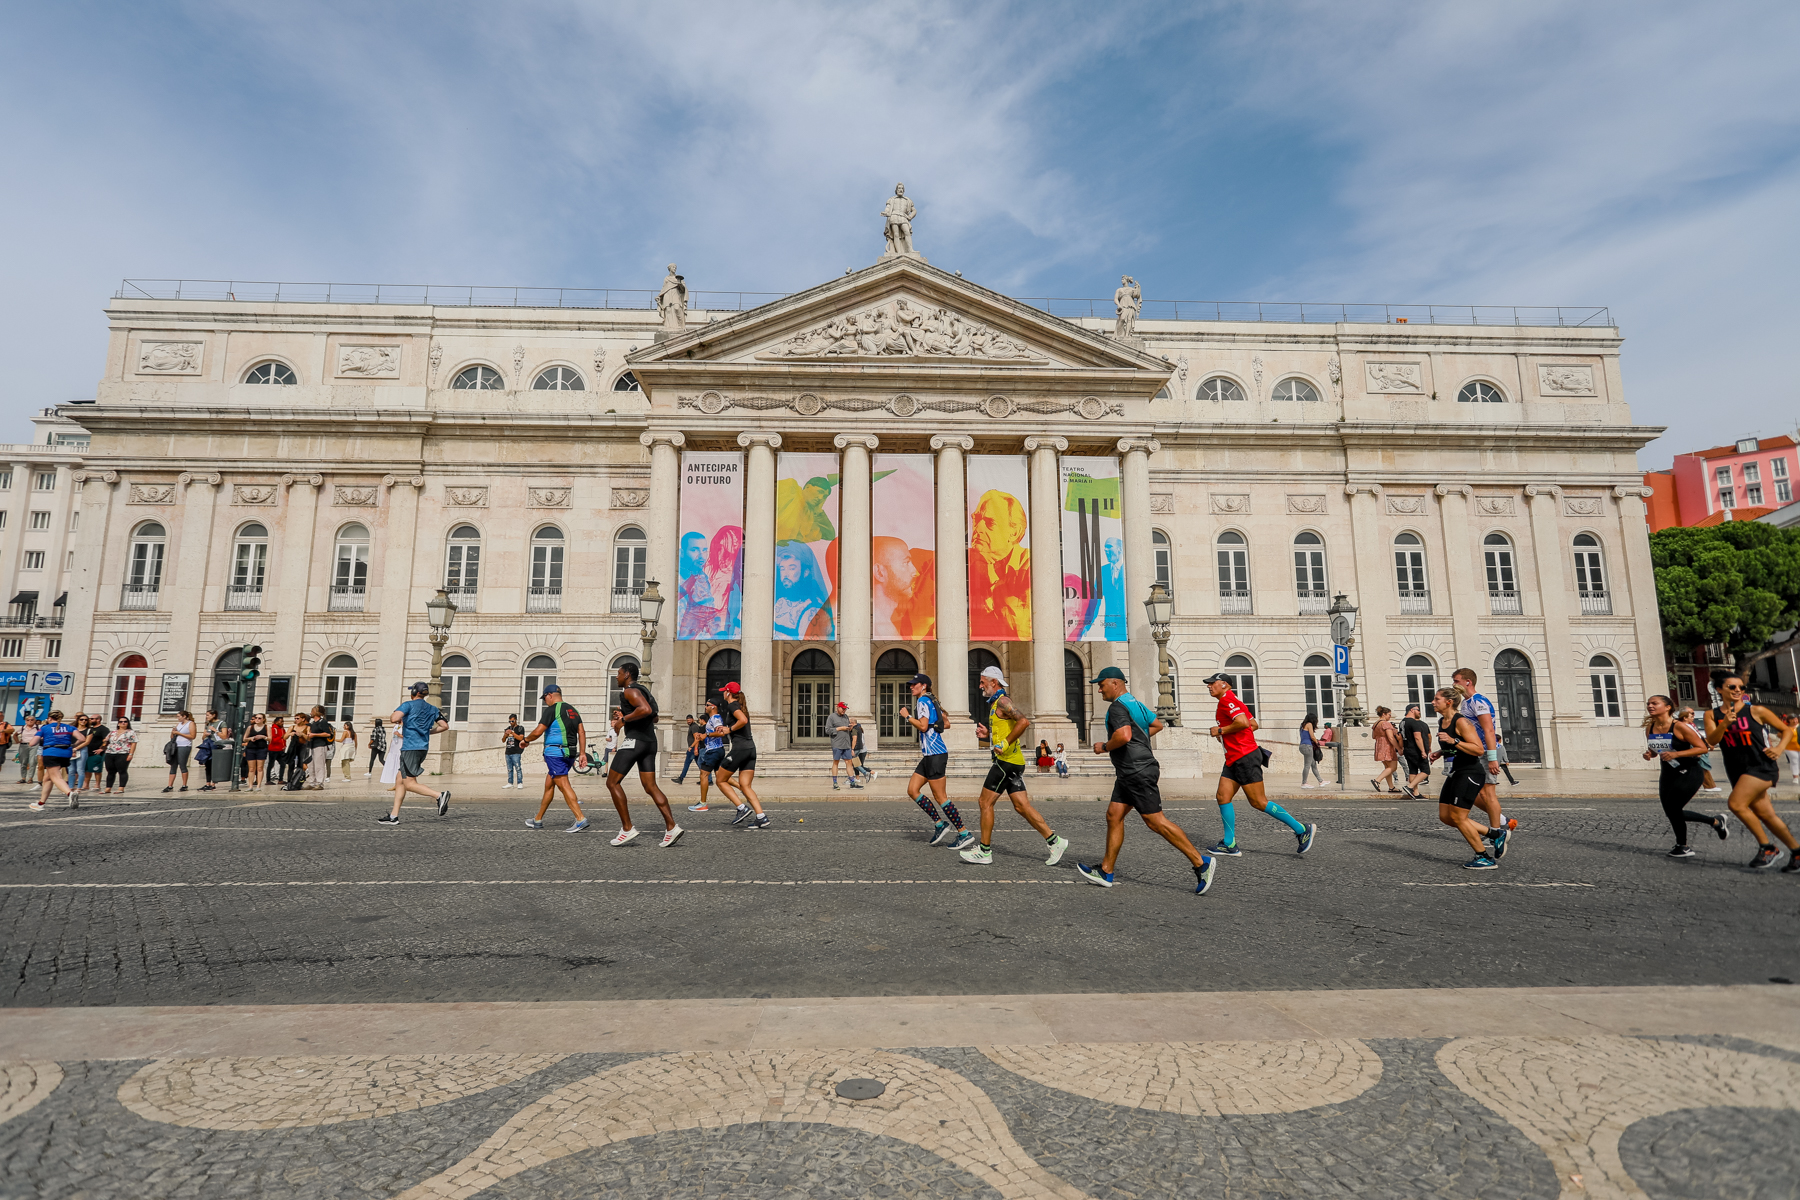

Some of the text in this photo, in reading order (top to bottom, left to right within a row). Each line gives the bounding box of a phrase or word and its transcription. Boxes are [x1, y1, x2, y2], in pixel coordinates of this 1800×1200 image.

[688, 464, 738, 472] ANTECIPAR
[687, 476, 731, 484] O FUTURO
[1337, 647, 1346, 671] P
